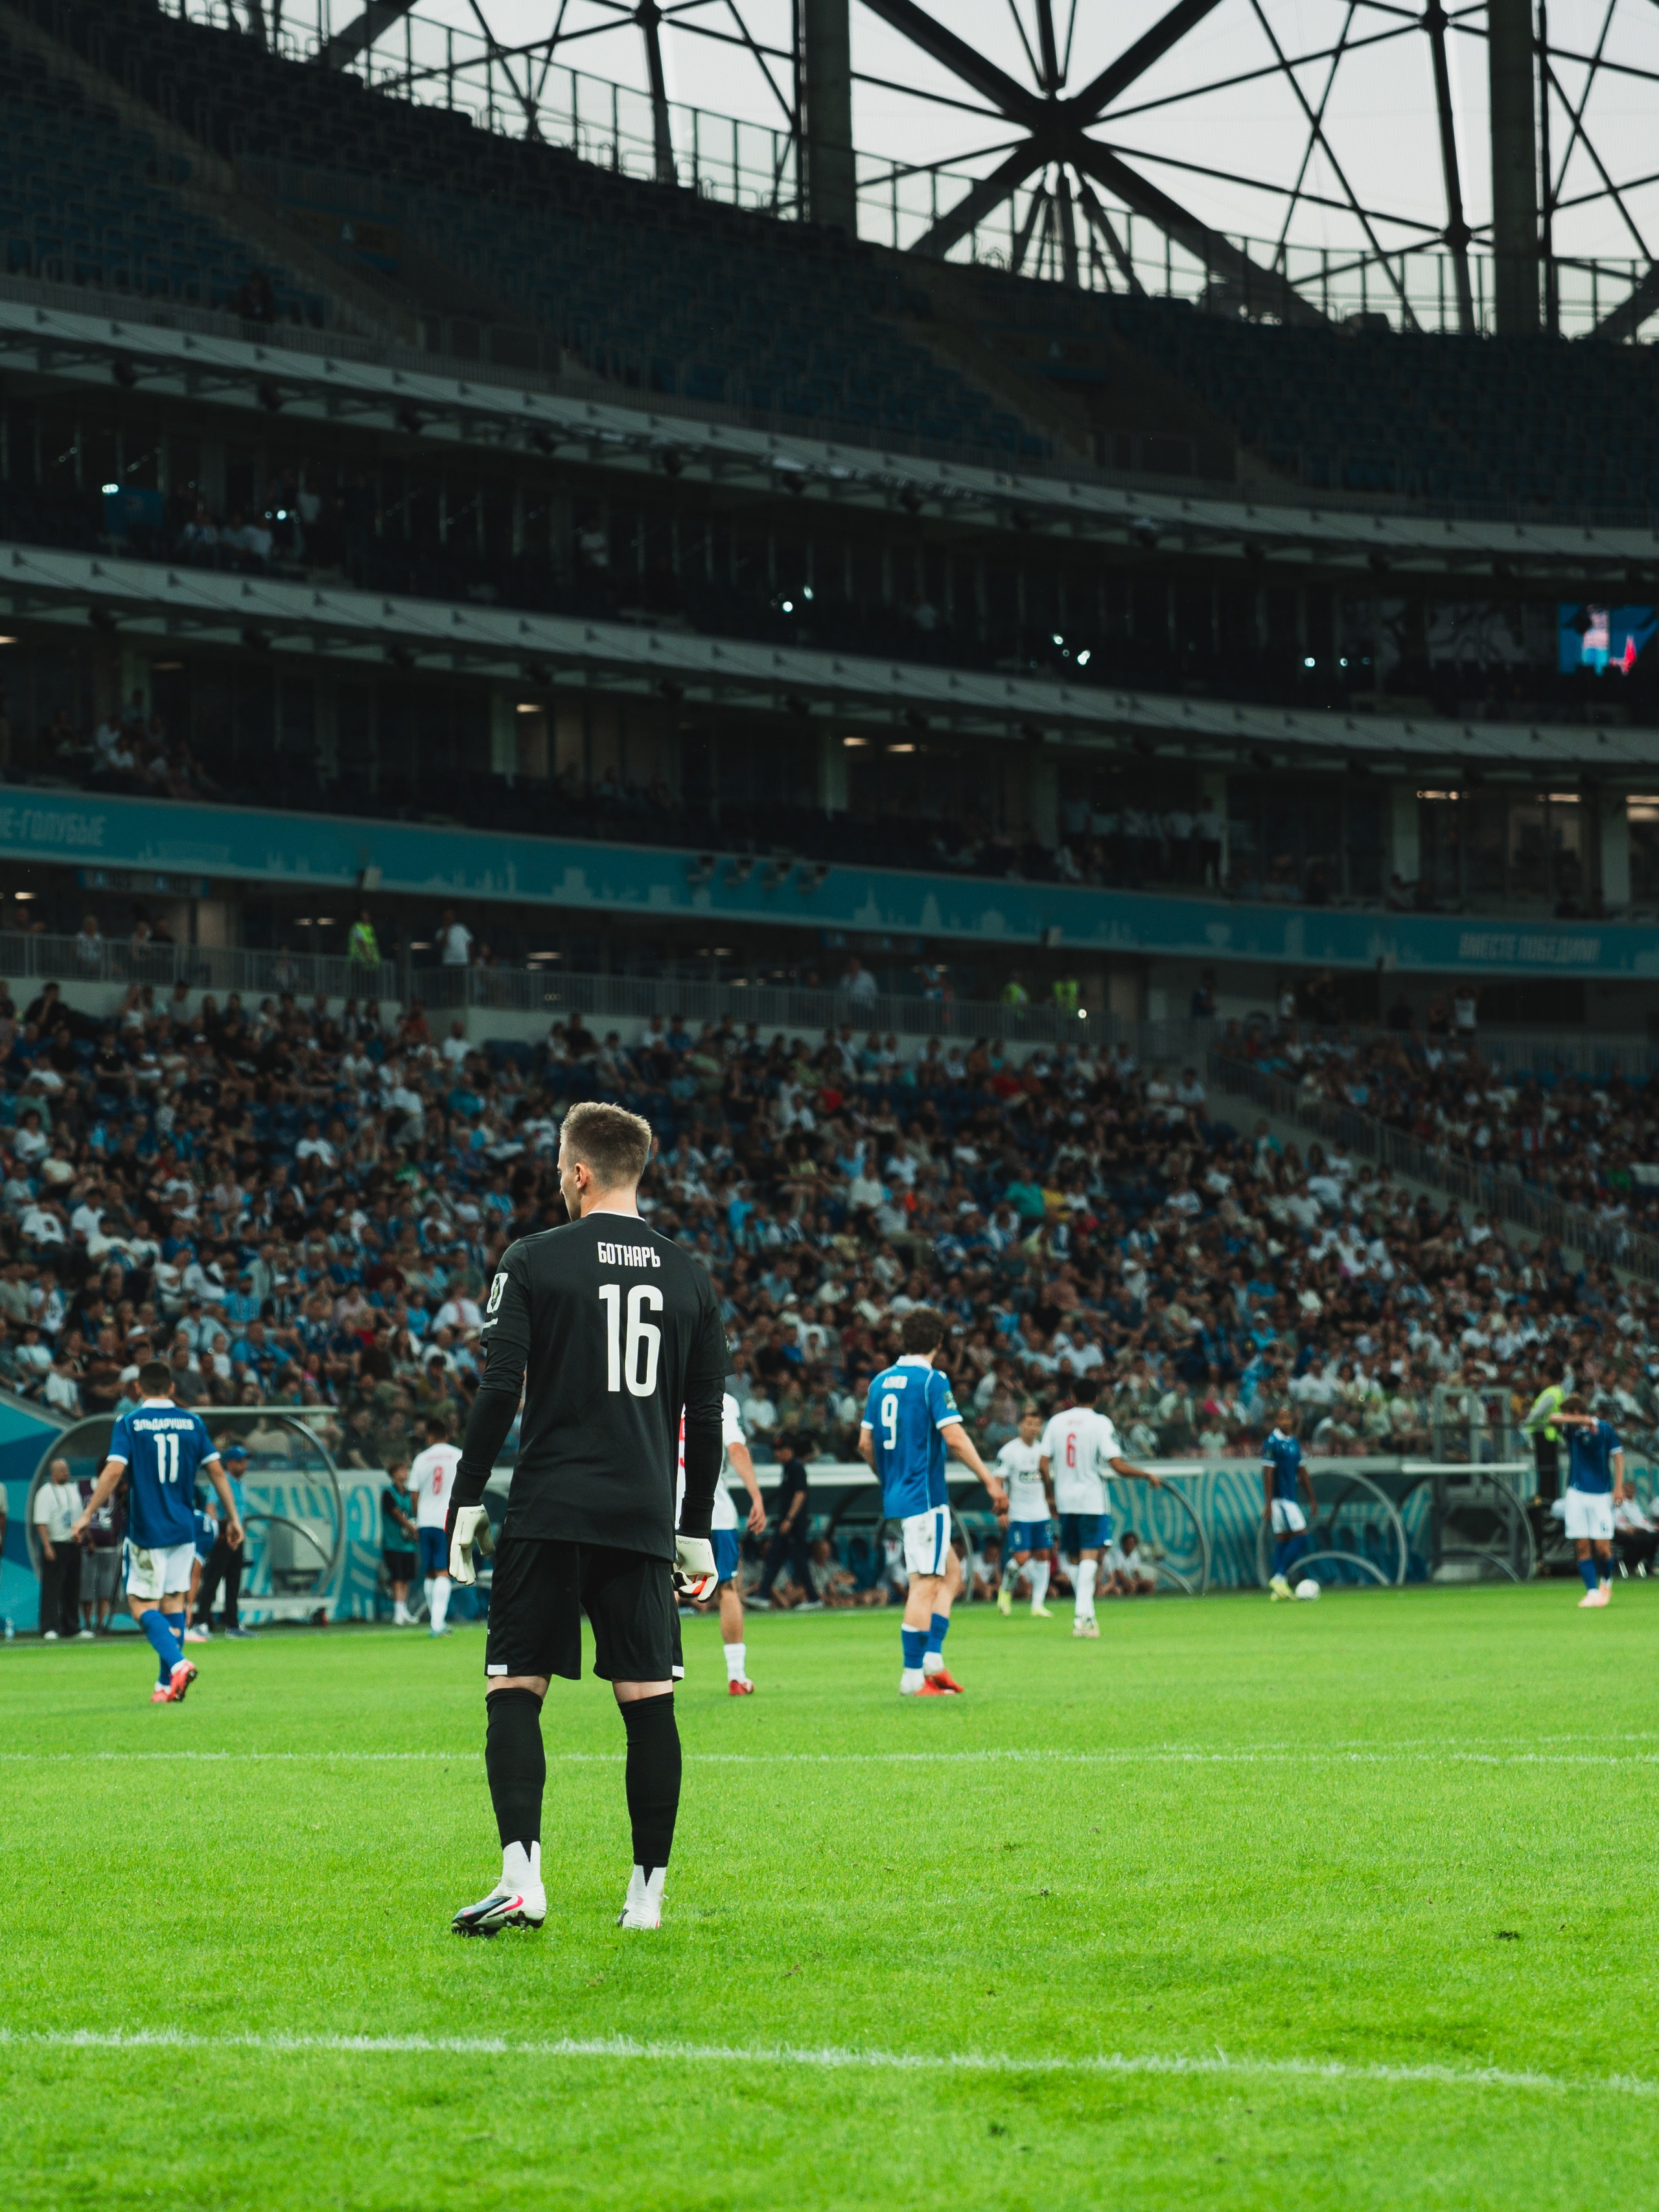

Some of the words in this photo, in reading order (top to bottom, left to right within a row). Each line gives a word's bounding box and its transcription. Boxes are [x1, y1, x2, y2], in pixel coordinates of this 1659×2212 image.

[597, 1241, 661, 1268] БОТНАРЬ
[599, 1284, 664, 1397] 16
[881, 1393, 899, 1450] 9
[153, 1433, 179, 1484] 11
[1065, 1432, 1076, 1469] 6
